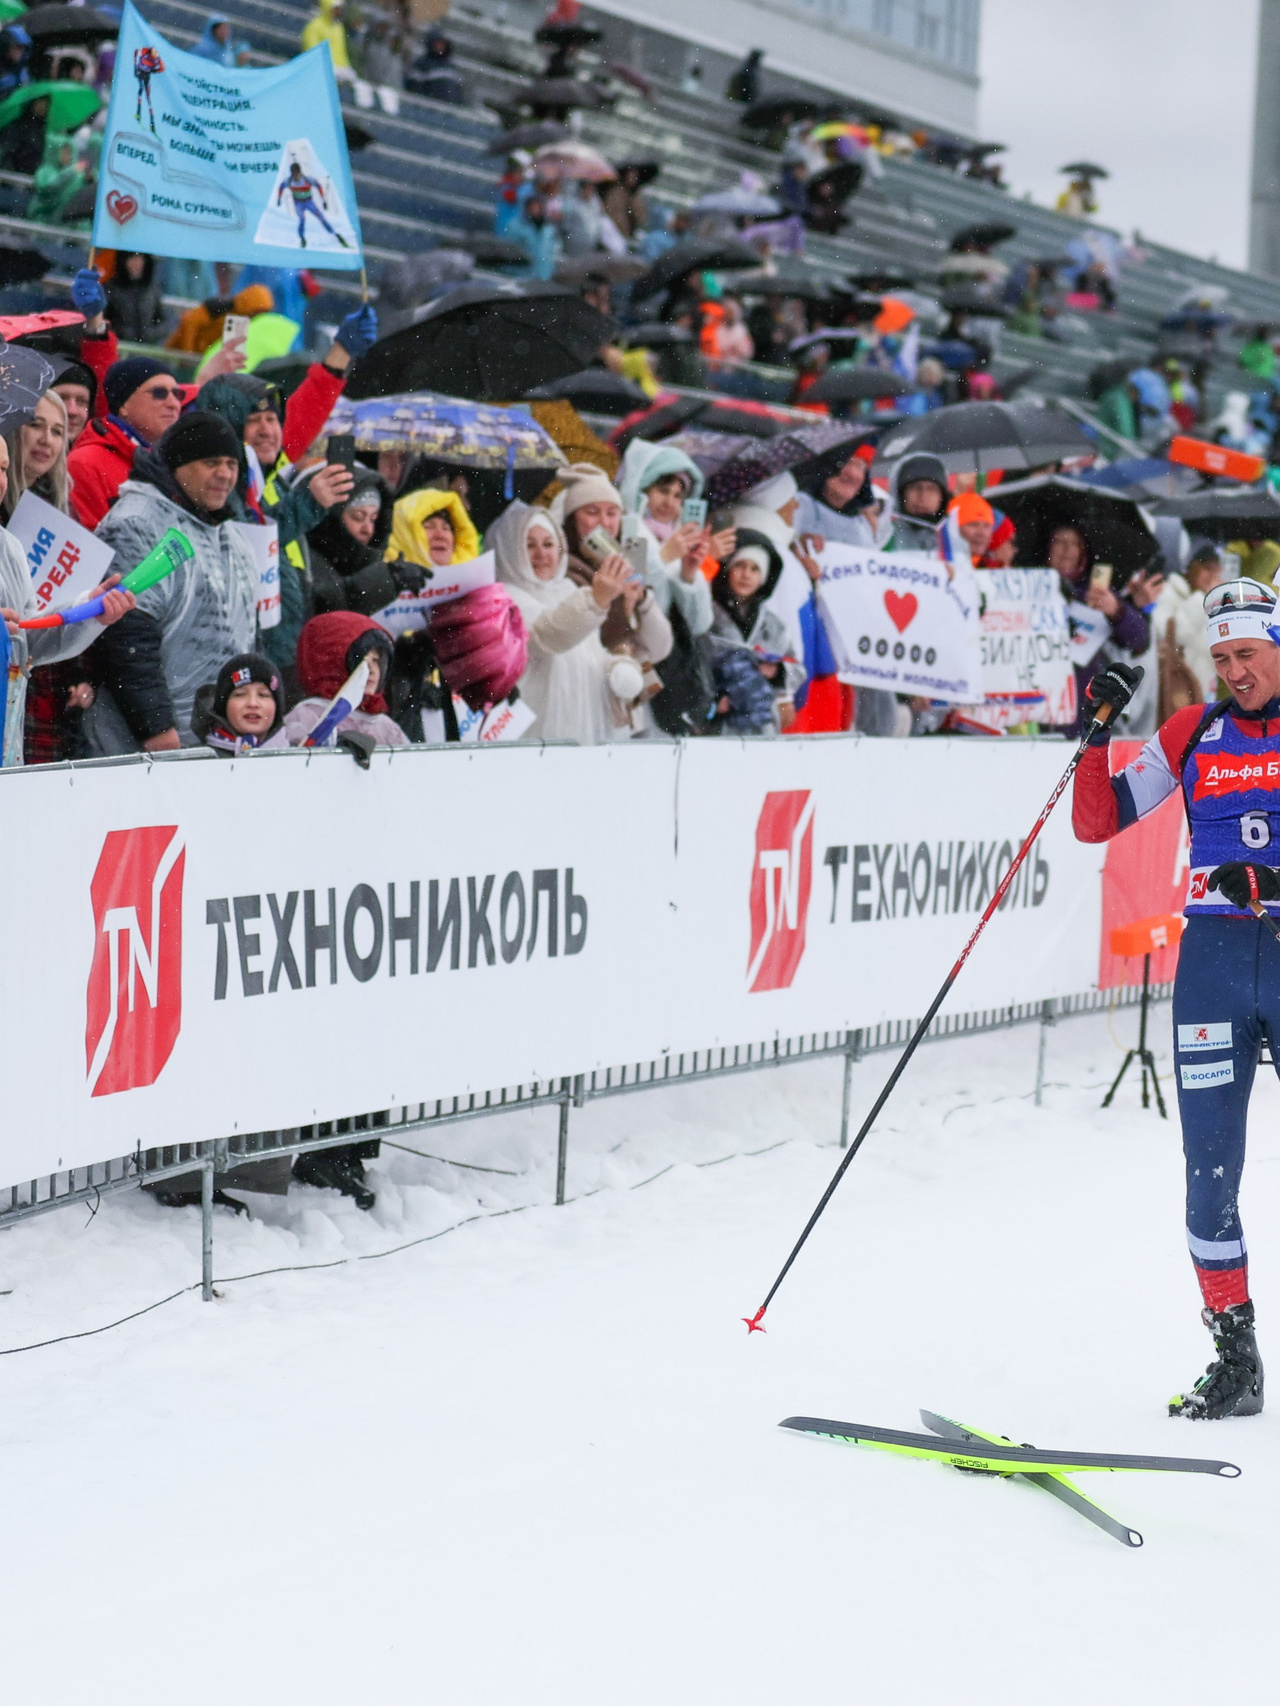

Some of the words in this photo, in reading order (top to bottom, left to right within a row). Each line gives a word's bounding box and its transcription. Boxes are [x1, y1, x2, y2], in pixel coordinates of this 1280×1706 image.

[151, 193, 183, 211] РОМА
[867, 559, 939, 588] Сидоров
[1205, 765, 1263, 782] Альфа
[1039, 761, 1077, 822] MOAX
[1240, 810, 1271, 850] 6
[823, 837, 1051, 925] ТЕХНОНИКОЛЬ
[205, 866, 589, 1001] ТЕХНОНИКОЛЬ
[1190, 1068, 1232, 1081] ФОСАГРО
[949, 1457, 989, 1469] FISCHER
